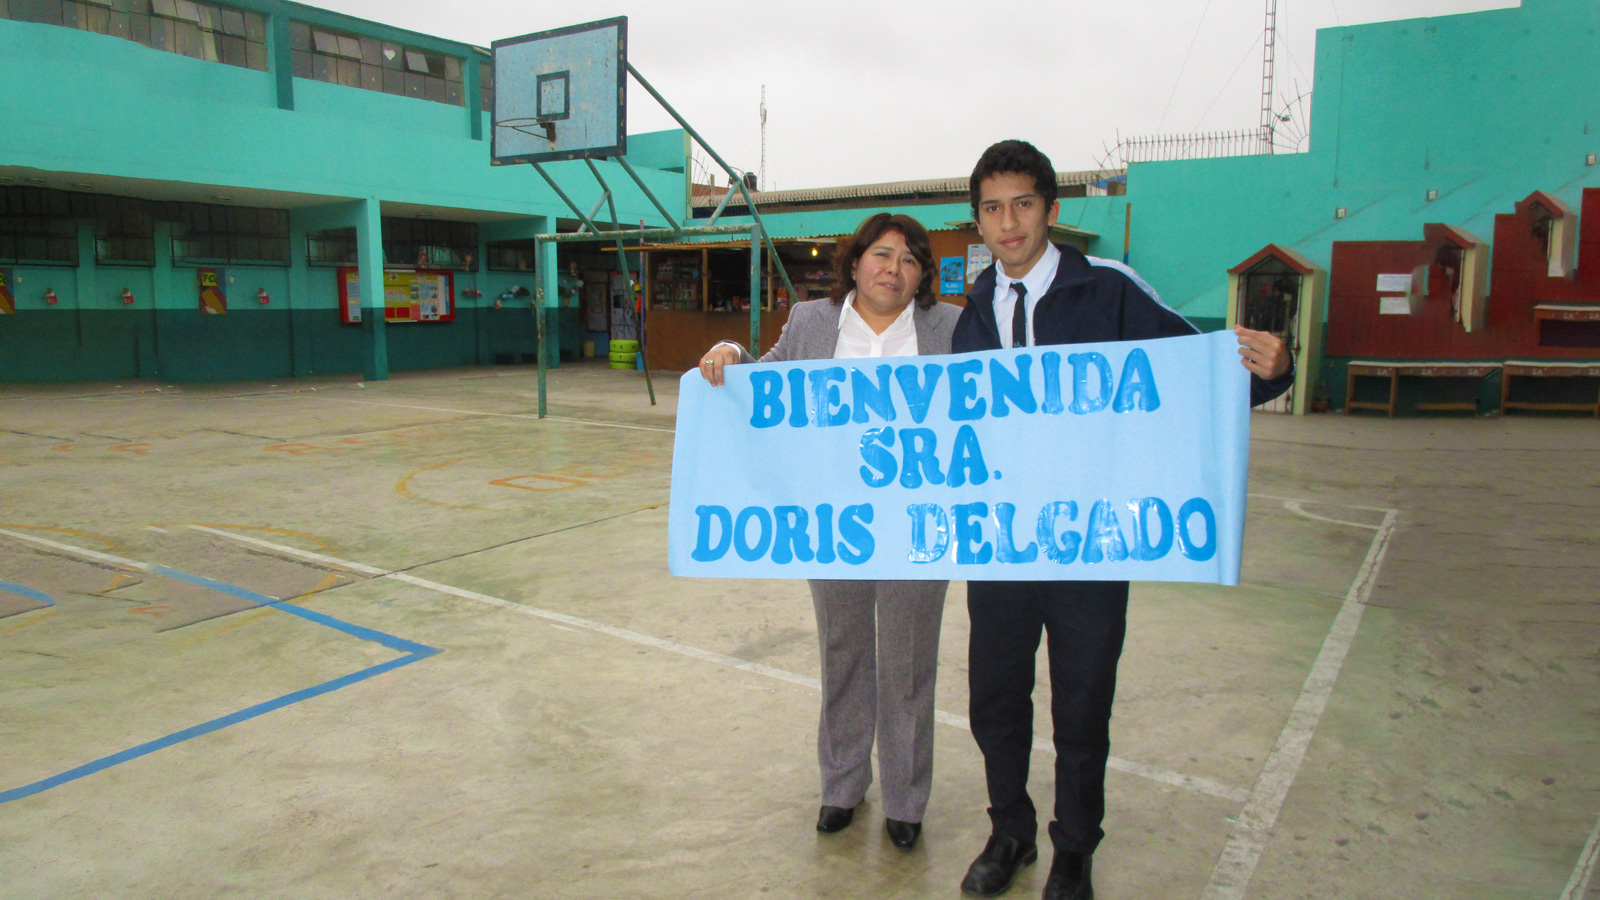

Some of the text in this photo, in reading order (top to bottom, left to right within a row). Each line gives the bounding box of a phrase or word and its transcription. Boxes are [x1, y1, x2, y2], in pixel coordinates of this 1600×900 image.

[749, 348, 1161, 428] BIENVENIDA
[859, 425, 1002, 489] SRA.
[691, 496, 1218, 565] DORIS DELGADO
